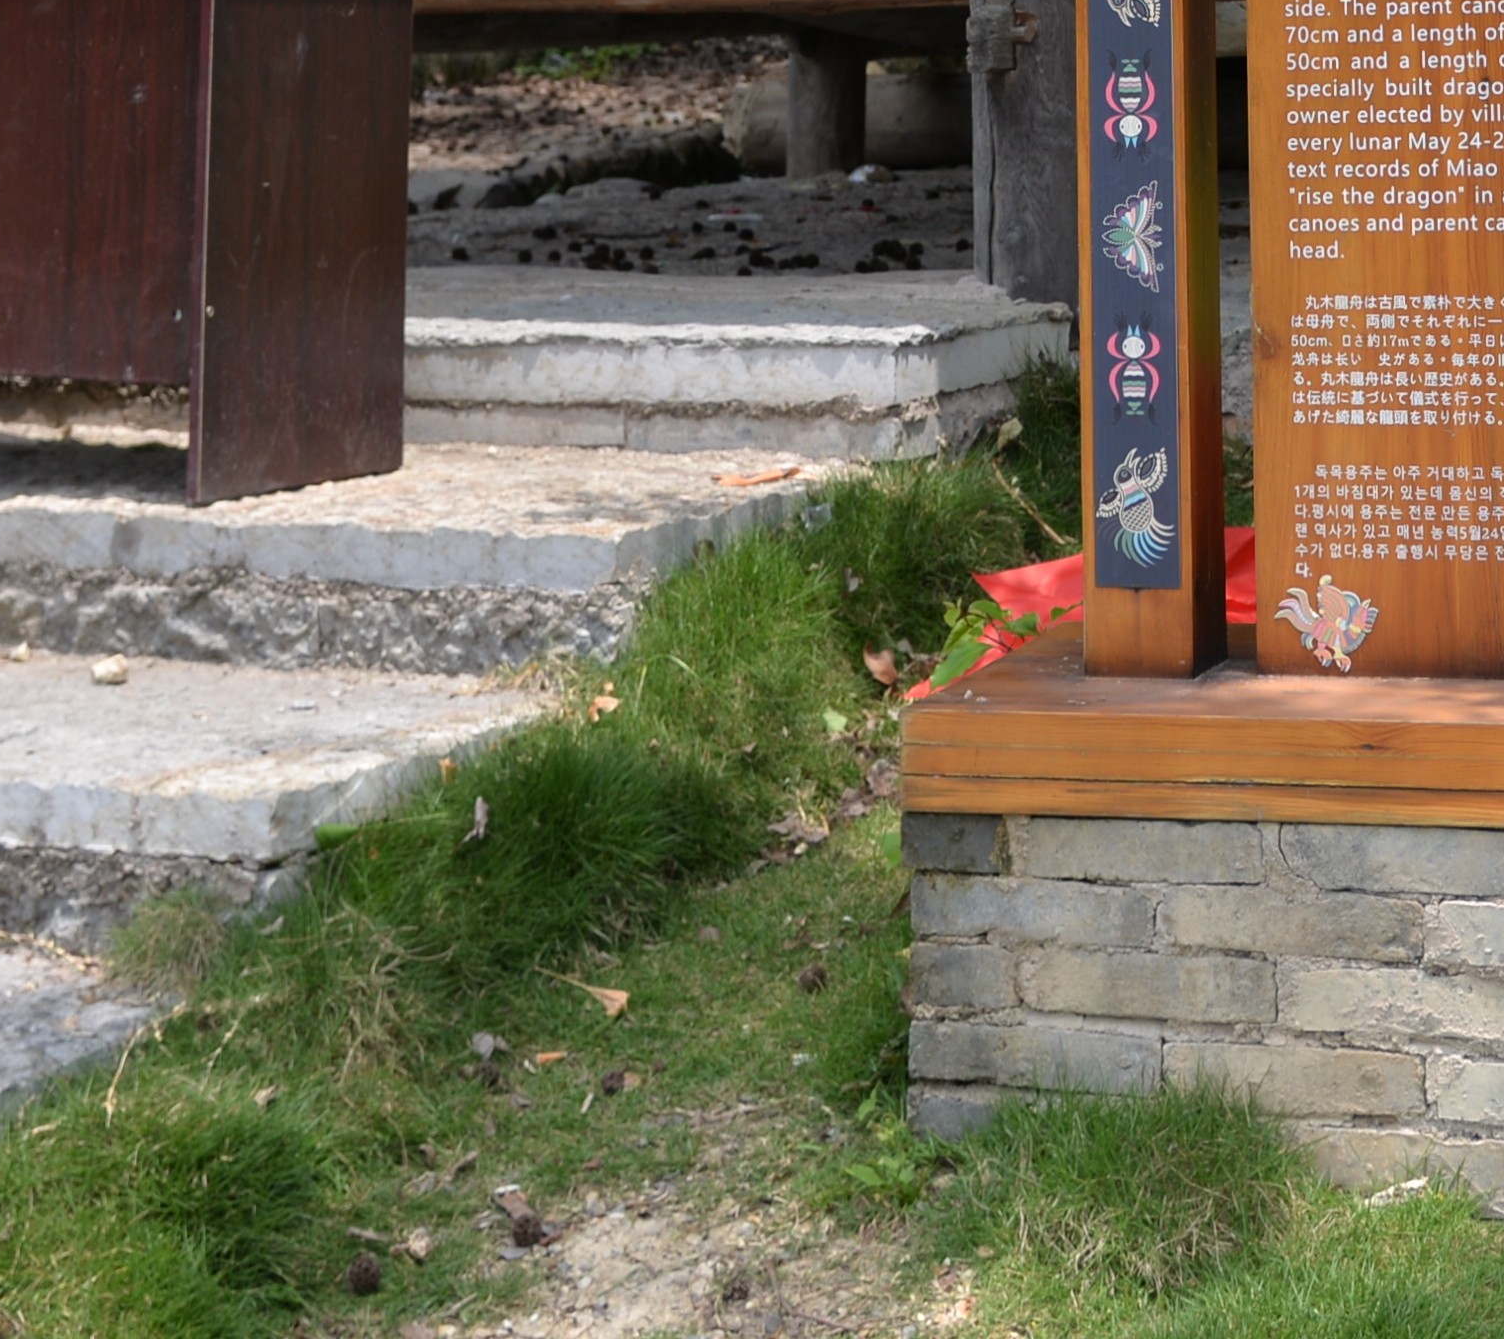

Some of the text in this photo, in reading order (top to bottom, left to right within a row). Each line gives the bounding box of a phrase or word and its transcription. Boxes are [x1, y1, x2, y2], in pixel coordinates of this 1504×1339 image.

[1284, 25, 1339, 44] 70cm
[1346, 23, 1384, 44] and
[1391, 28, 1403, 43] a
[1410, 22, 1477, 47] length
[1286, 77, 1375, 102] specially
[1385, 76, 1433, 97] built
[1286, 109, 1351, 125] owner
[1357, 103, 1432, 124] elected
[1440, 103, 1465, 128] by
[1288, 186, 1334, 205] "rise
[1341, 185, 1375, 205] the
[1383, 185, 1465, 210] dragon"
[1474, 185, 1493, 204] in
[1288, 217, 1360, 233] canoes
[1365, 212, 1404, 233] and
[1411, 214, 1479, 237] parent
[1289, 239, 1345, 260] head.
